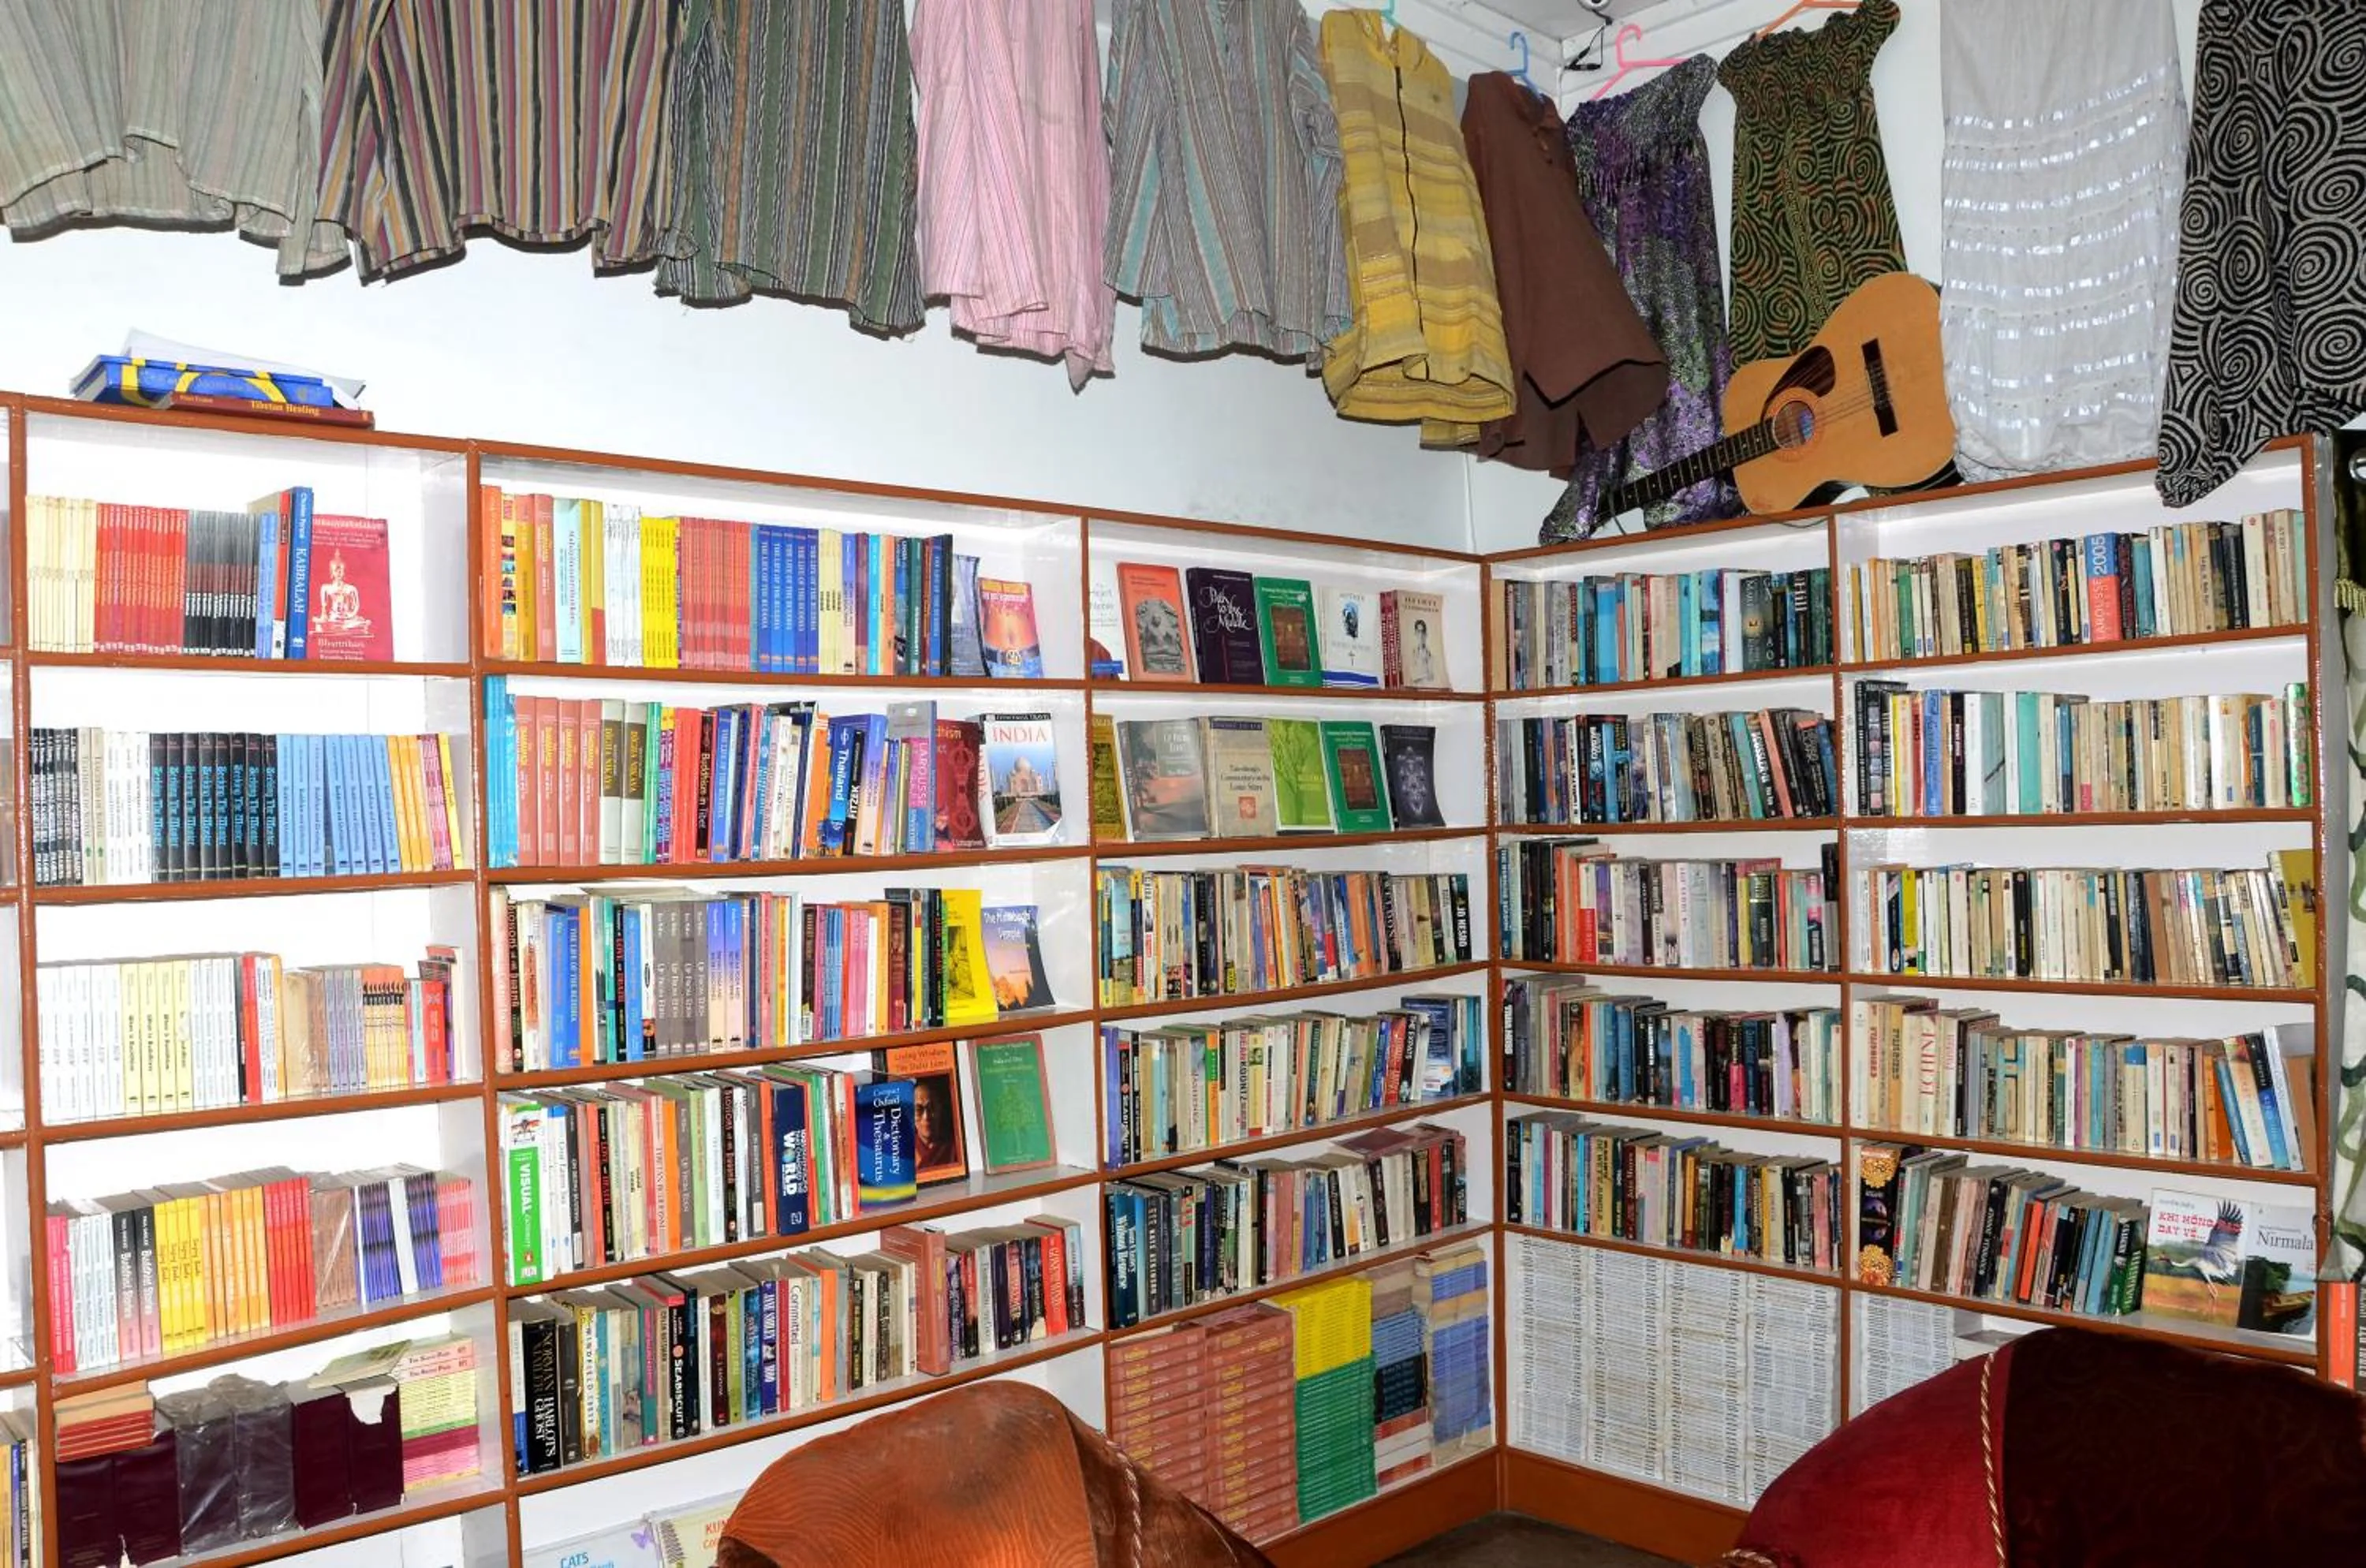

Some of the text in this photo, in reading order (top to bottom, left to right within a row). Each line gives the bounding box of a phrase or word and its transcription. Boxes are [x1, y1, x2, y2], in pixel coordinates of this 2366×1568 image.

[286, 403, 320, 416] Healing
[2091, 535, 2109, 575] 2005
[295, 549, 307, 614] KABBALAH
[1794, 583, 1808, 612] Hill
[2093, 578, 2106, 640] LAROUSSE
[992, 726, 1047, 743] INDIA
[699, 753, 710, 795] Buddhism
[834, 749, 849, 801] Thailand
[918, 742, 928, 806] LAROUSSE
[699, 808, 707, 829] Tibet
[848, 784, 860, 819] FITZEK
[1457, 906, 1466, 917] JO
[894, 1049, 947, 1062] Living Wisdom
[1405, 1031, 1415, 1059] EXPATS
[873, 1097, 900, 1107] Oxford
[873, 1110, 883, 1182] Thesaurus
[890, 1107, 901, 1174] Dictionary
[782, 1131, 797, 1196] WORLD
[521, 1163, 532, 1214] VISUAL
[2158, 1211, 2181, 1223] KHI
[1117, 1215, 1127, 1290] Without Remorse
[1148, 1229, 1157, 1249] KATE
[2258, 1230, 2314, 1251] Nirmala
[141, 1250, 154, 1316] Buddhist Stories
[123, 1290, 134, 1319] Stories
[790, 1285, 802, 1345] Committed
[763, 1312, 775, 1340] SMILEY
[543, 1332, 554, 1391] NORMAN
[674, 1358, 684, 1423] SEABISCUIT
[534, 1398, 545, 1441] GHOST
[561, 1552, 588, 1568] CATS
